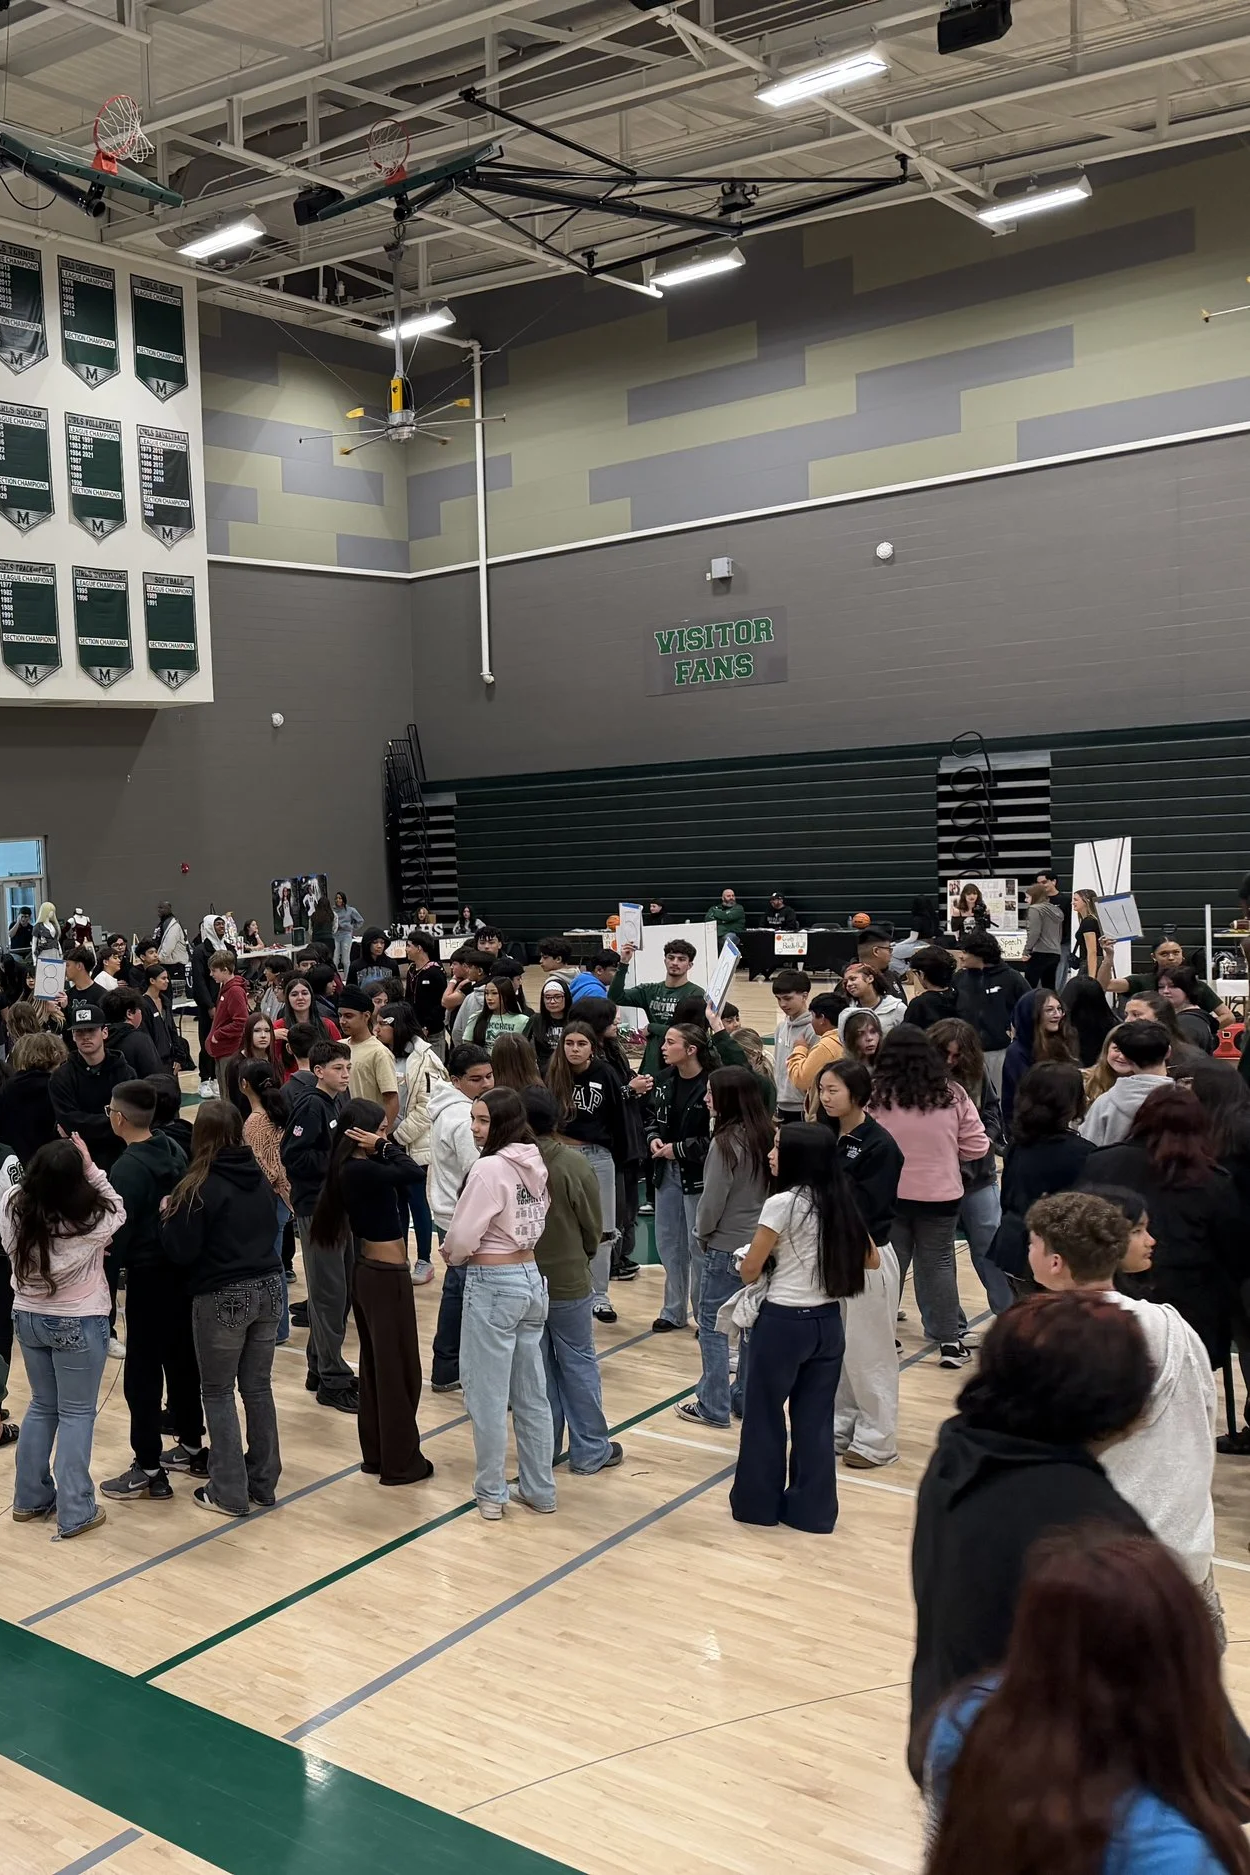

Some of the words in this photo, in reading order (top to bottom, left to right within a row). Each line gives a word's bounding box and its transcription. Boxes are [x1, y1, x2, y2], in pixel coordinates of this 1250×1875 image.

[6, 257, 38, 270] CHAMPIONS
[10, 352, 23, 366] M
[156, 381, 167, 394] M
[16, 408, 42, 418] SOCCER
[14, 417, 45, 428] CHAMPIONS
[18, 479, 48, 490] CHAMPIONS
[17, 512, 30, 524] M
[92, 520, 104, 532] M
[162, 528, 173, 539] M
[155, 576, 184, 586] SOFTBALL
[654, 616, 775, 655] VISITOR
[25, 666, 38, 679] M
[675, 653, 754, 686] FANS
[167, 671, 178, 682] M
[43, 964, 59, 995] 8
[573, 1086, 603, 1114] AP
